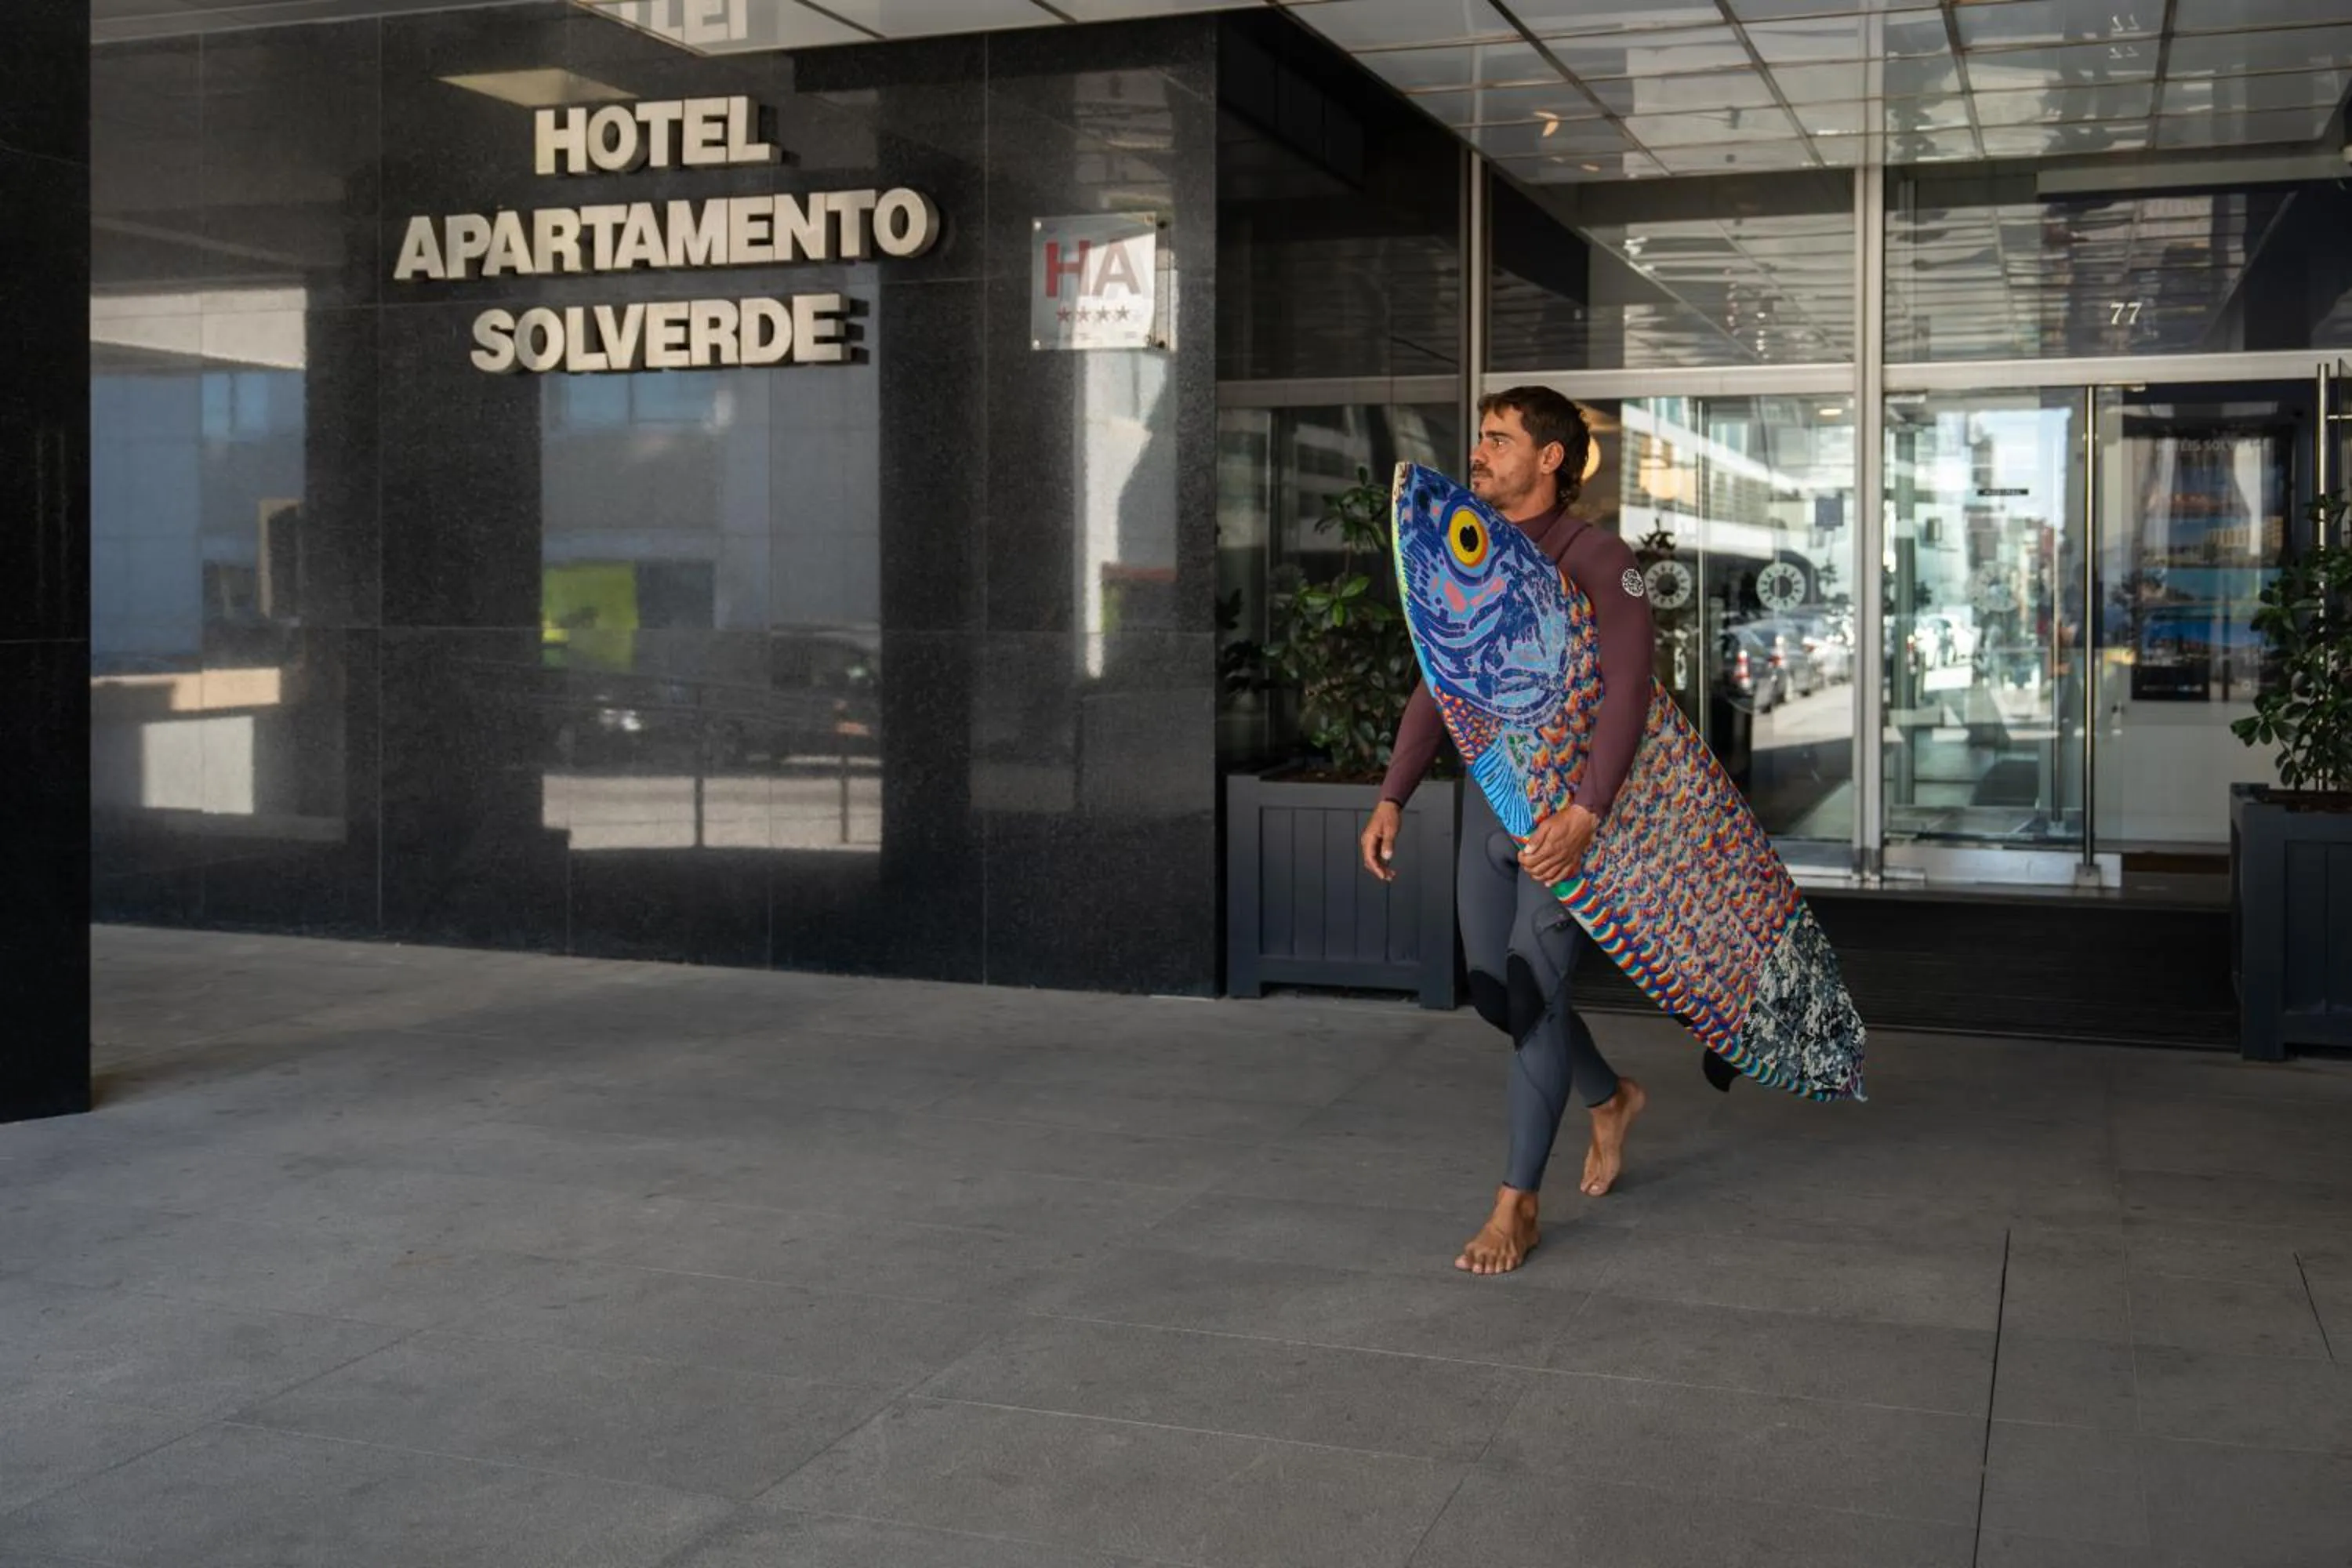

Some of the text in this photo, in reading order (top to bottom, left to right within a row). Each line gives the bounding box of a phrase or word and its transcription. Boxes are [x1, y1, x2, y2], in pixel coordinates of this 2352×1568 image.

[535, 96, 773, 175] HOTEL
[394, 187, 933, 280] APARTAMENTO
[1046, 238, 1142, 298] HA
[470, 293, 842, 372] SOLVERDE
[2111, 302, 2143, 325] 77
